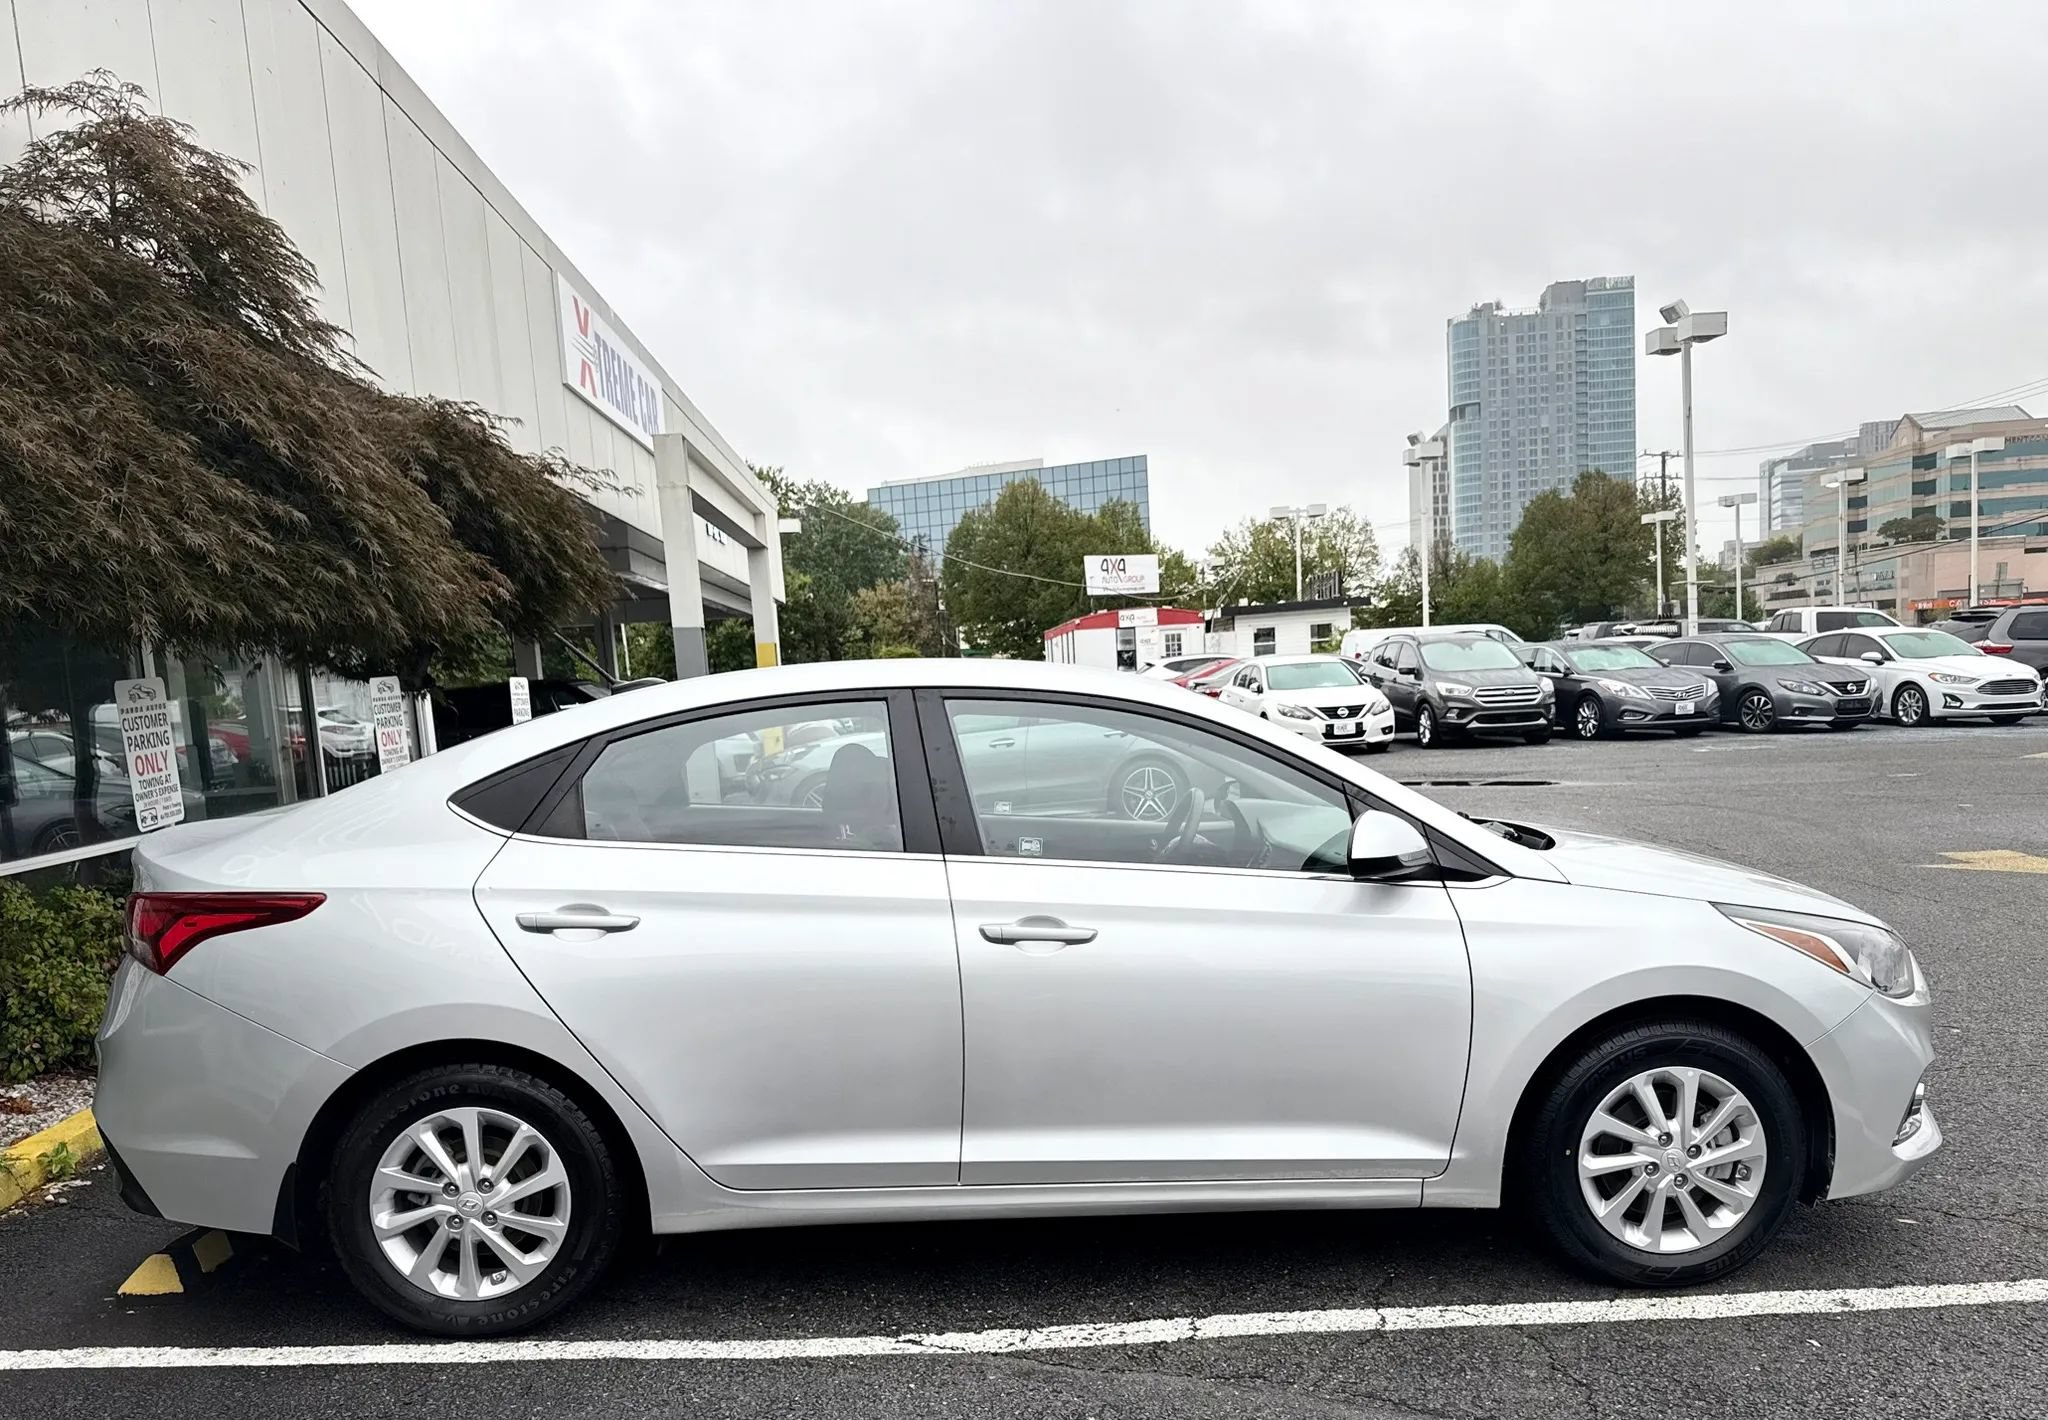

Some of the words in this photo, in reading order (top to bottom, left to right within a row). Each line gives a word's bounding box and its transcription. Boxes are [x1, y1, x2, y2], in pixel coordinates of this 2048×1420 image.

[374, 702, 402, 715] CUSTOMER
[122, 713, 169, 733] CUSTOMER
[376, 715, 403, 728] PARKING
[127, 730, 170, 752] PARKING
[381, 730, 402, 747] ONLY
[135, 750, 169, 777] ONLY
[138, 776, 164, 791] TOWING
[163, 773, 172, 785] AT
[135, 787, 159, 802] OWNER'S
[158, 784, 179, 798] EXPENSE
